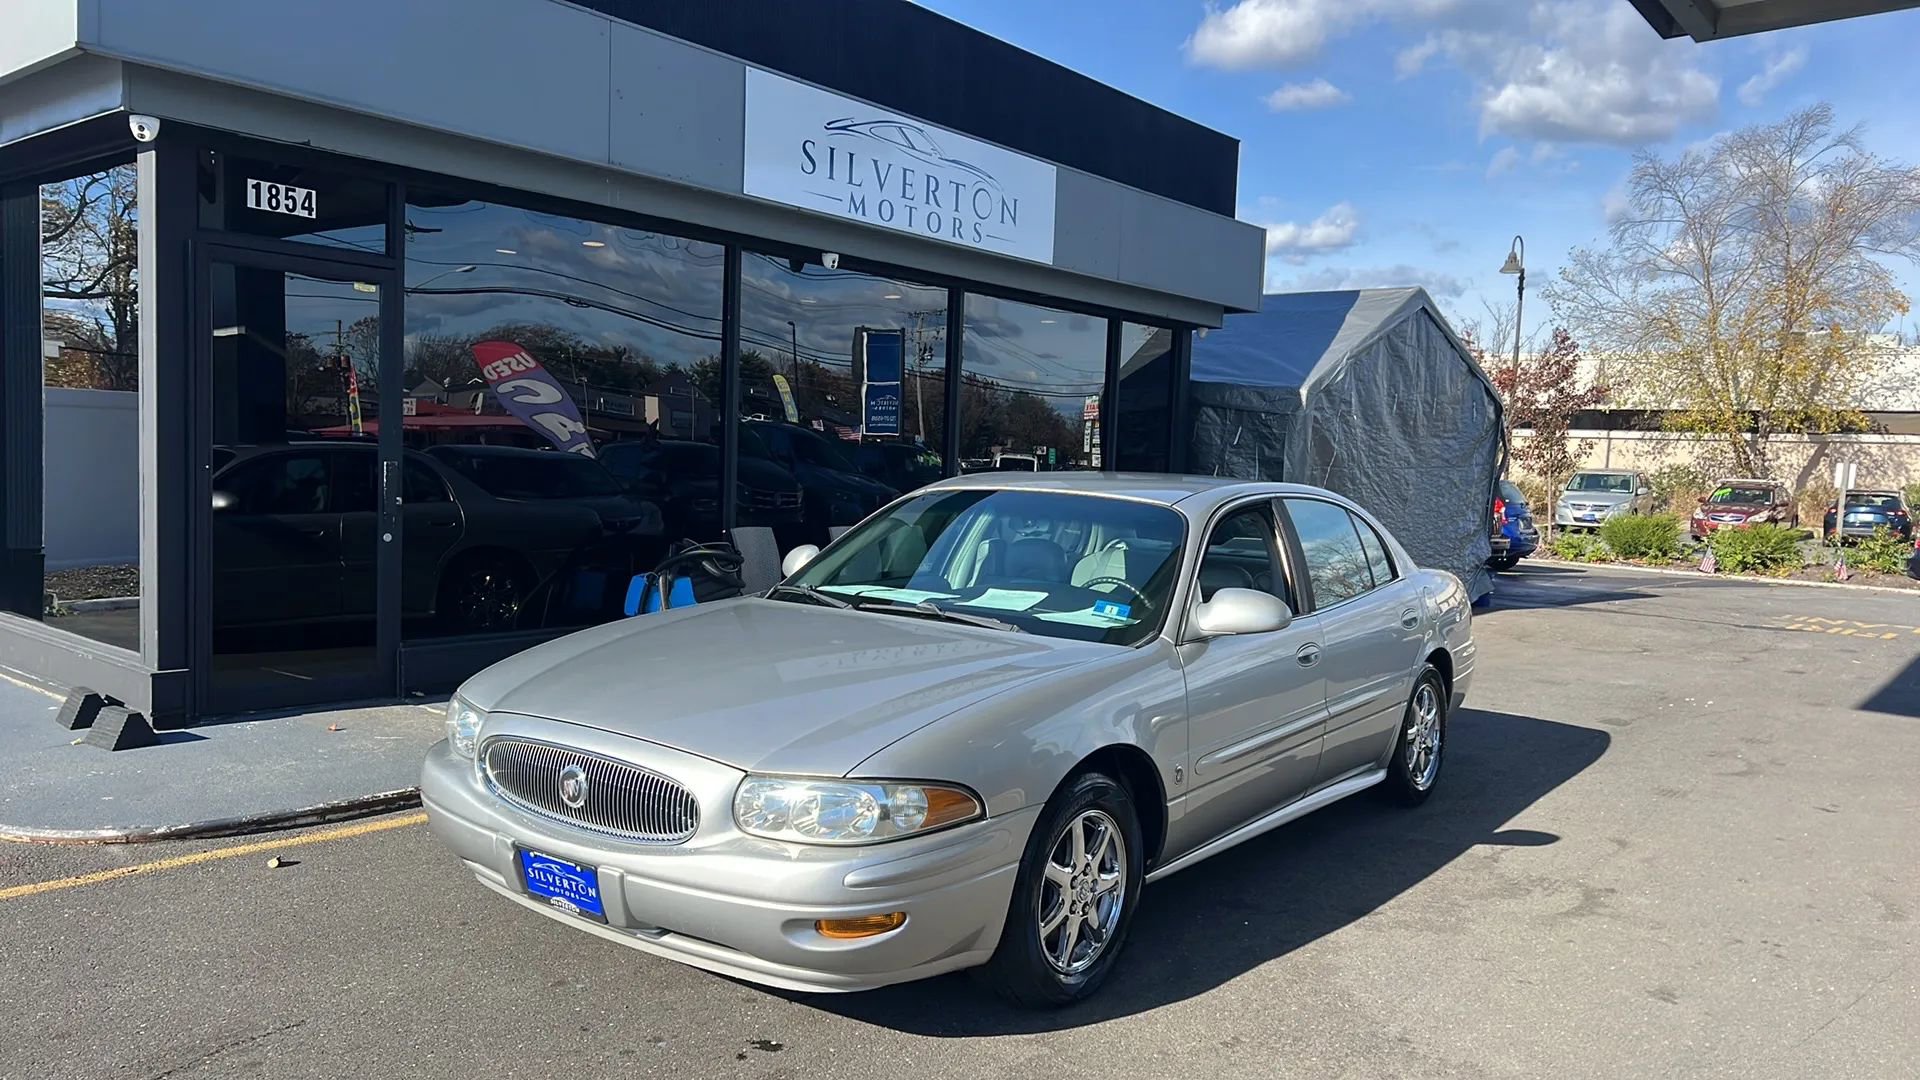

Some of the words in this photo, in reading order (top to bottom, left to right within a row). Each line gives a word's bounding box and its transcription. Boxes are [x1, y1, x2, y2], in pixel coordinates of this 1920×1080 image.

[251, 182, 315, 216] 1854
[801, 139, 1018, 227] SILVERTON
[848, 191, 983, 244] MOTORS
[528, 867, 597, 898] SILVERTON
[549, 886, 580, 900] MOTORS
